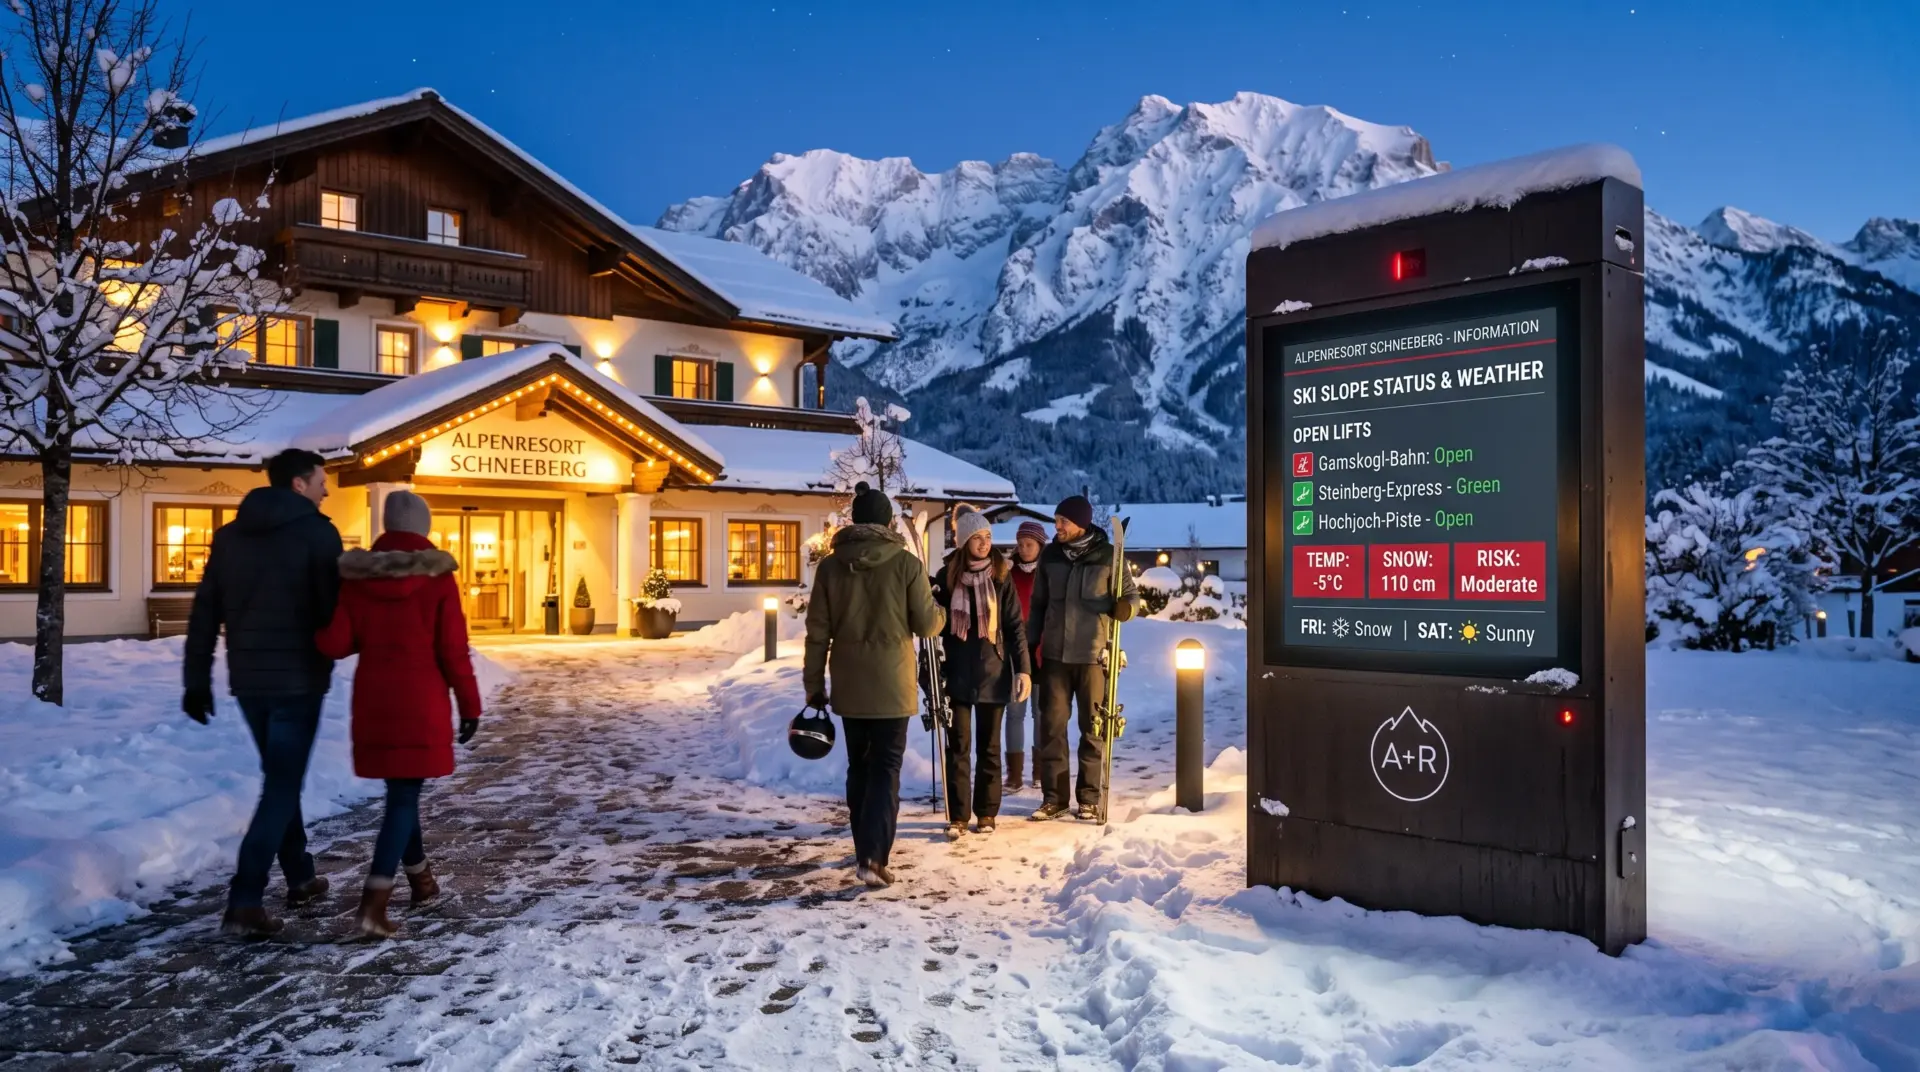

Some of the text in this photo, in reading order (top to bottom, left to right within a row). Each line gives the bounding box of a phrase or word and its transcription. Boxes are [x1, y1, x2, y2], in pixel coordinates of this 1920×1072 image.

[1295, 343, 1367, 364] ALPENRESORT
[1370, 333, 1443, 354] SCHNEEBERG
[1454, 319, 1539, 343] INFORMATION
[1293, 360, 1543, 405] SKI SLOPE STATUS & WEATHER
[1293, 421, 1371, 443] OPEN LIFTS
[452, 433, 585, 454] ALPENRESORT
[451, 455, 586, 477] SCHNEEBERG
[1319, 447, 1473, 471] Gamskogl-Bahn: Open
[1319, 481, 1442, 502] Steinberg-Express
[1456, 477, 1500, 494] Green
[1319, 512, 1421, 533] Hochjoch-Piste
[1435, 510, 1473, 530] Open
[1307, 552, 1349, 567] TEMP:
[1383, 551, 1433, 567] SNOW:
[1477, 549, 1520, 566] RISK:
[1313, 574, 1342, 591] -5°C
[1382, 575, 1435, 592] 110 cm
[1461, 575, 1537, 593] Moderate
[1301, 619, 1535, 647] FRI: Snow SAT: Sunny
